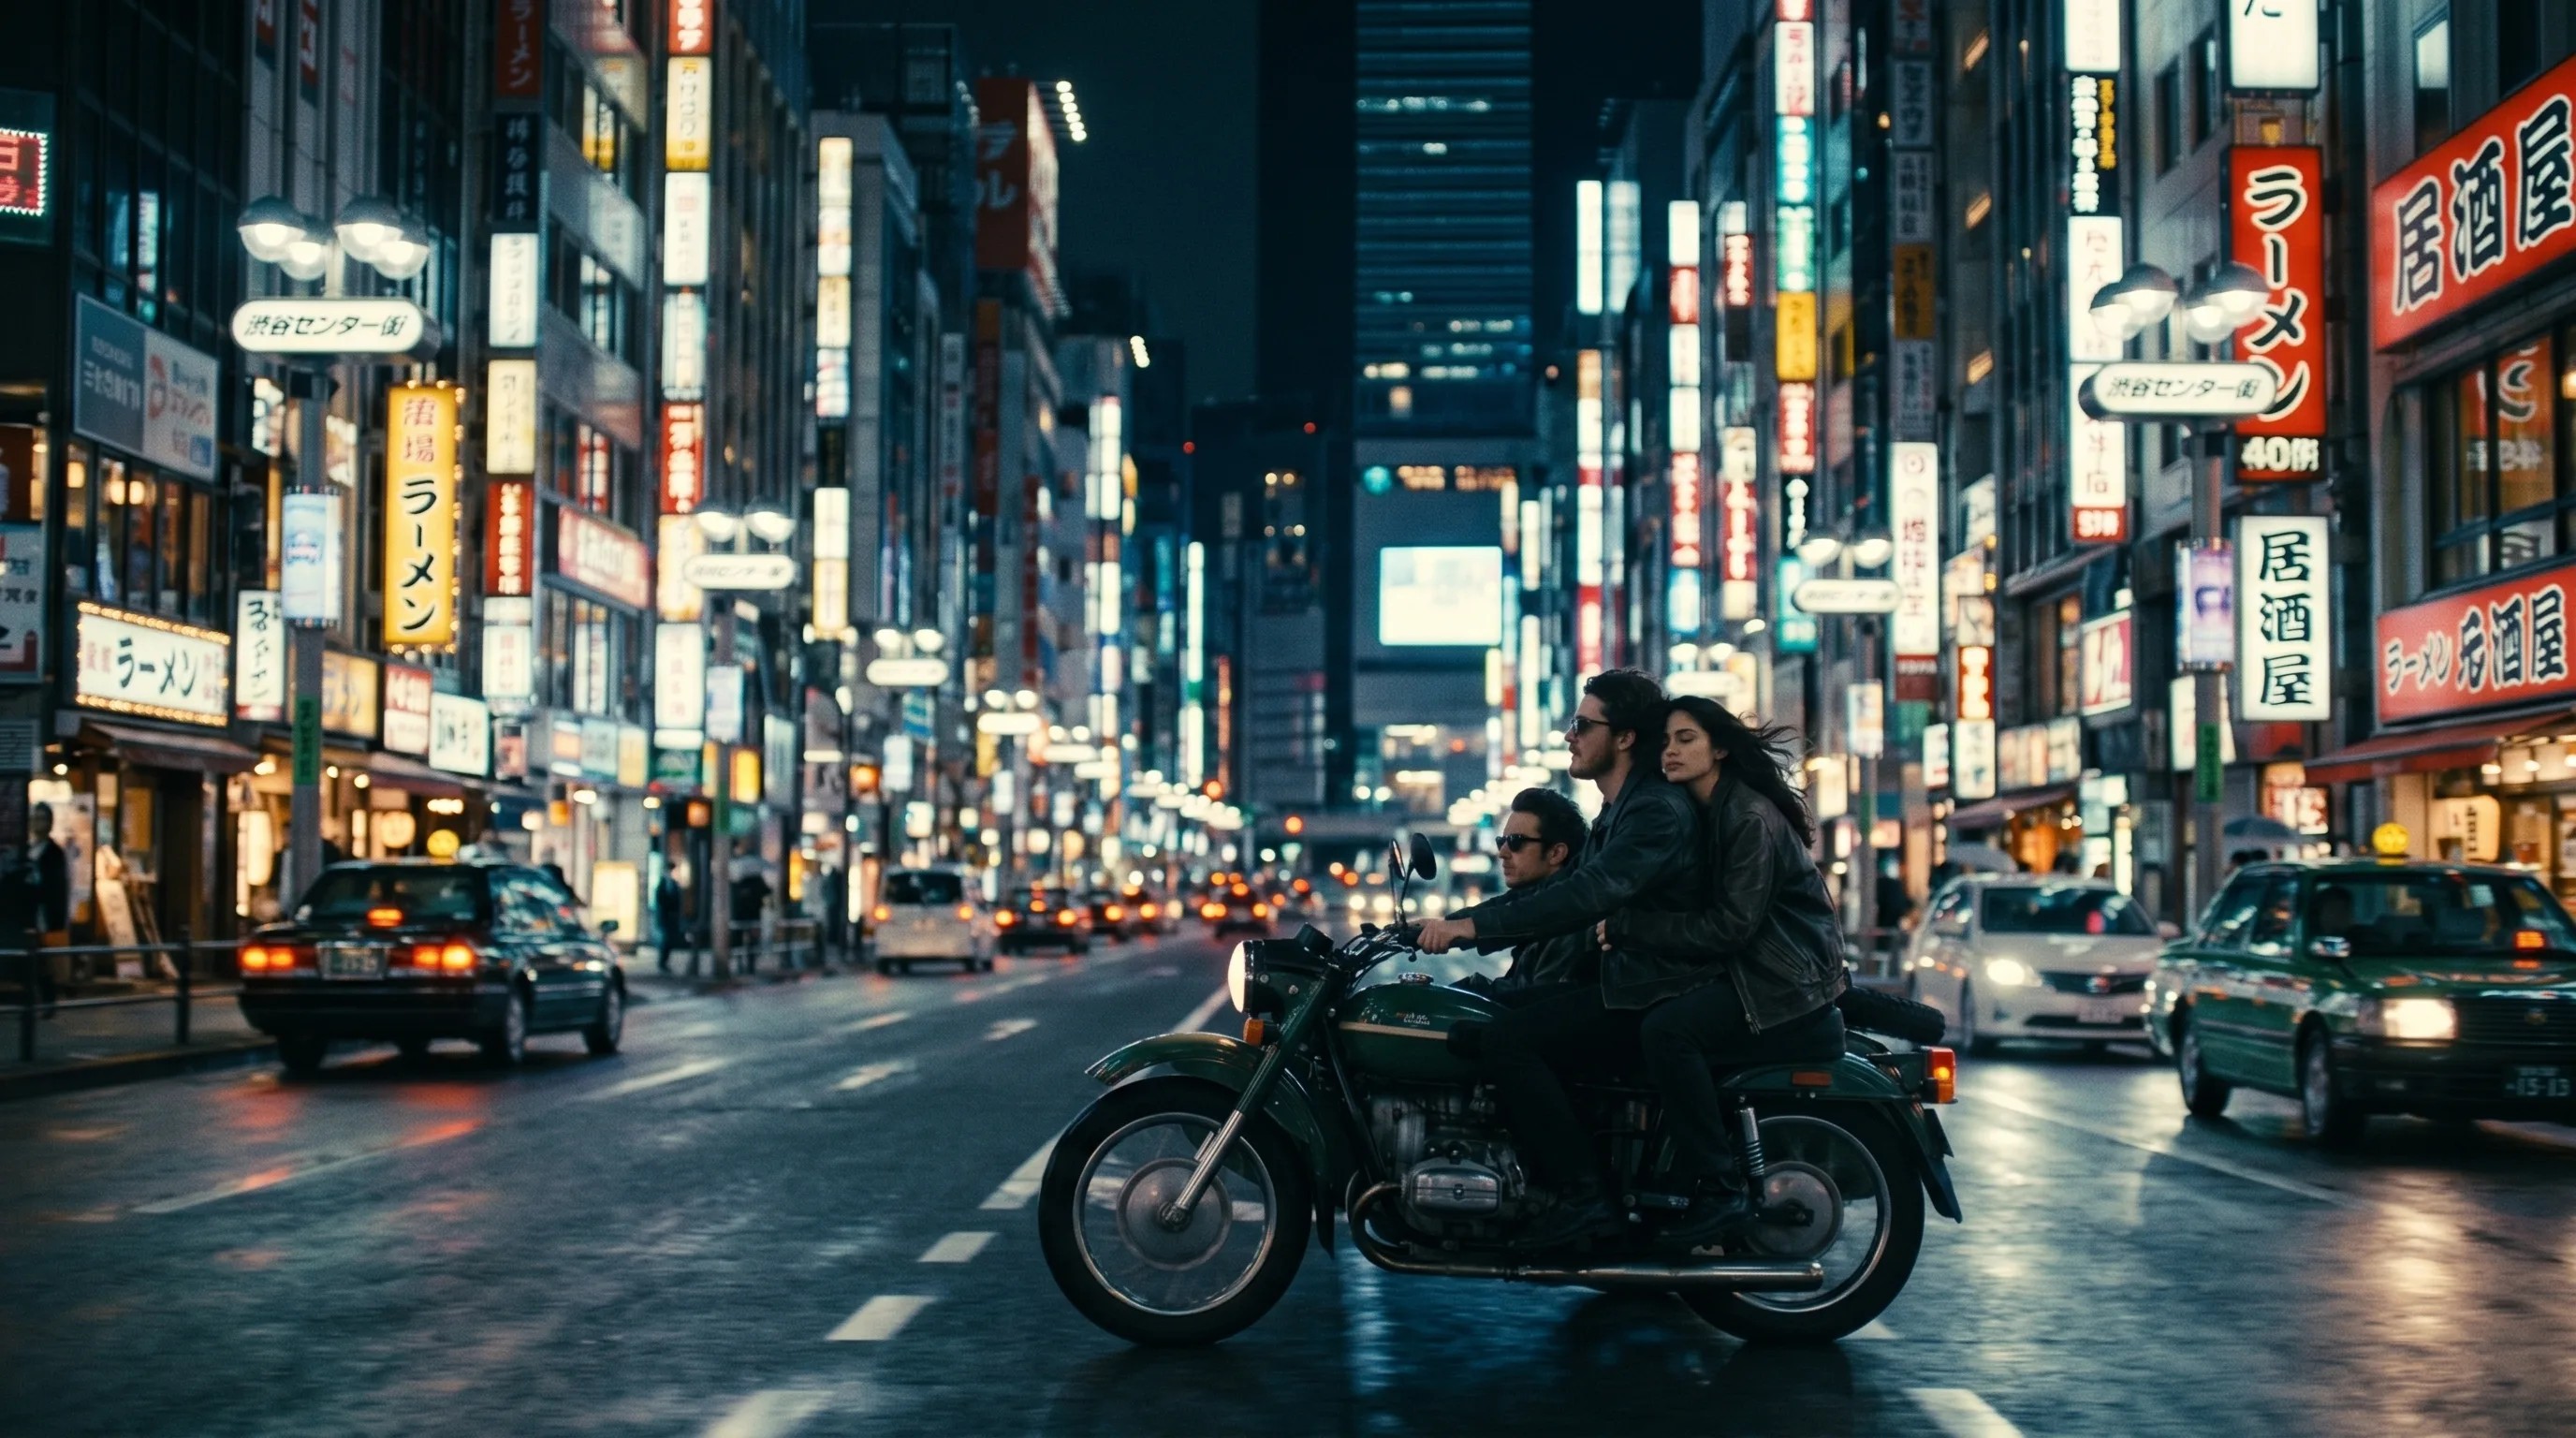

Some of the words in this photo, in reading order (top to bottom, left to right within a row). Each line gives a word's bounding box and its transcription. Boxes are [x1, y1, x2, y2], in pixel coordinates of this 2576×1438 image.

[2245, 164, 2309, 421] ラーメン
[2393, 95, 2573, 315] 居酒屋
[117, 637, 198, 697] ラーメン
[2260, 530, 2312, 705] 居酒屋
